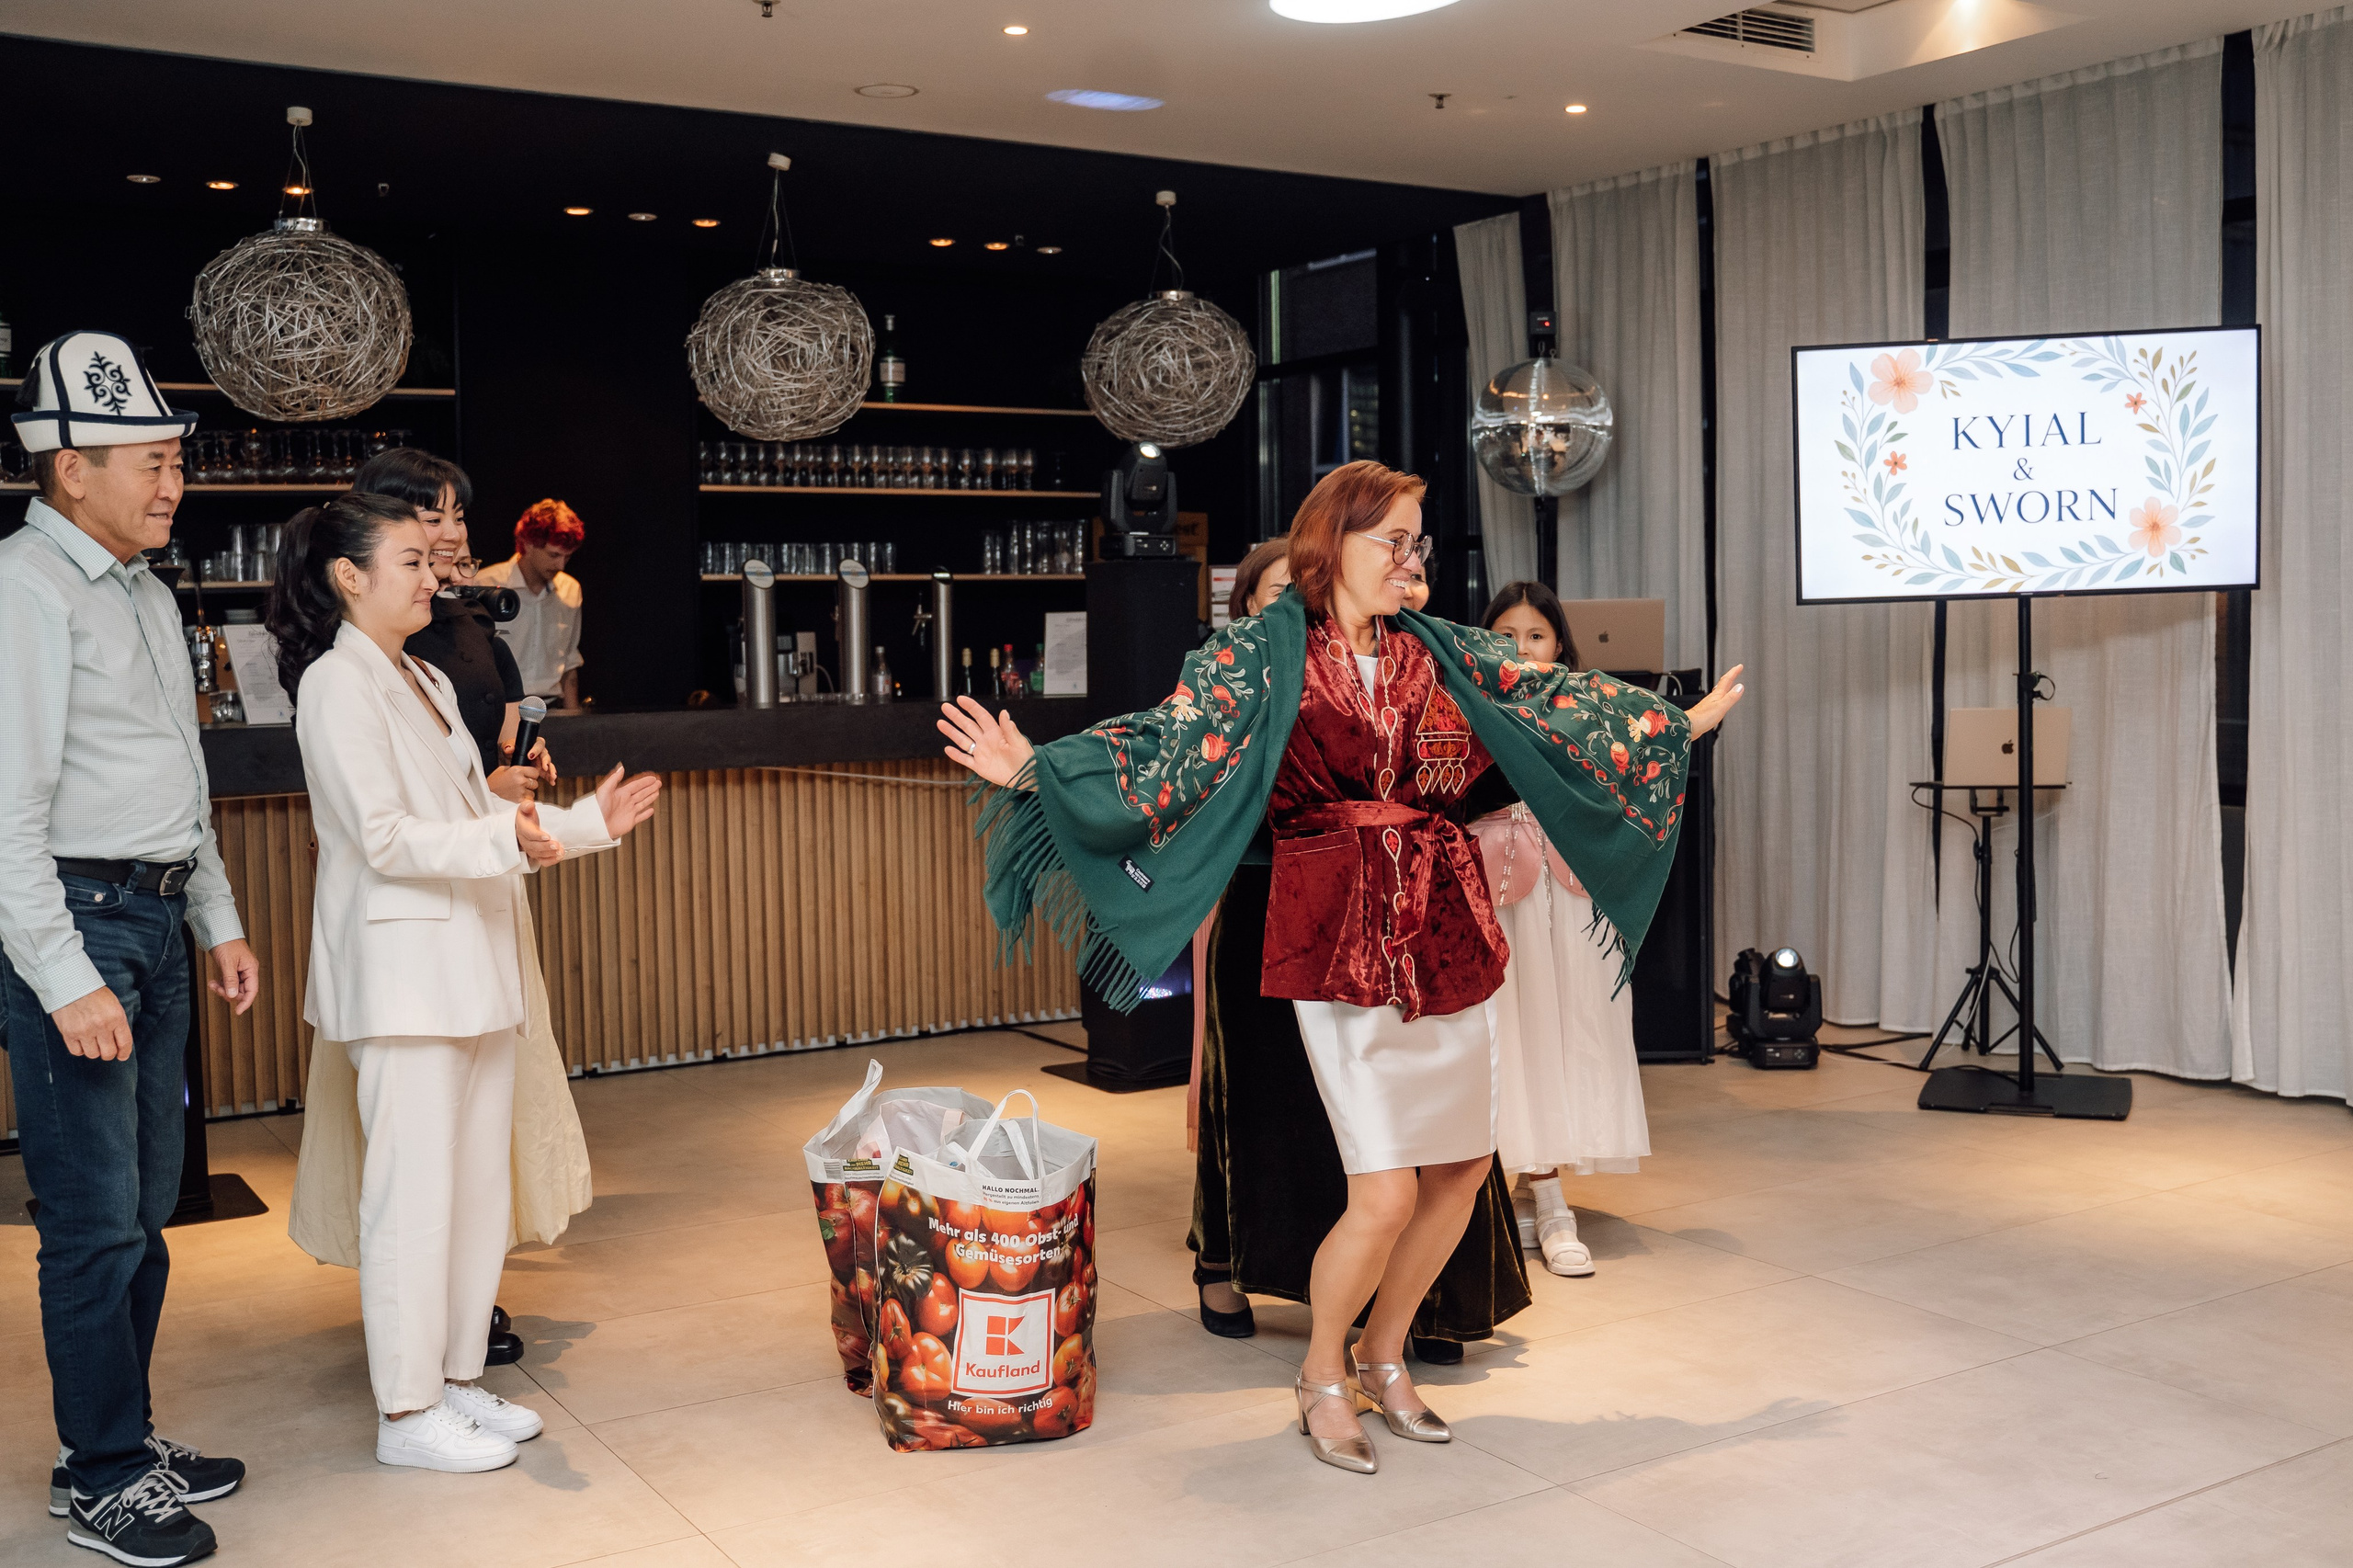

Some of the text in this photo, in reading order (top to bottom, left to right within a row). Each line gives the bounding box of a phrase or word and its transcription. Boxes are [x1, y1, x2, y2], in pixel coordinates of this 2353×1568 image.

[1952, 411, 2102, 450] KYIAL
[2012, 457, 2034, 482] &
[1943, 487, 2119, 528] SWORN
[927, 1212, 1079, 1248] Mehr als 400 Obst- und
[955, 1243, 1061, 1266] Gemüsesorten
[965, 1359, 1040, 1378] Kaufland
[948, 1397, 1053, 1415] Hier bin ich richtig
[94, 1502, 136, 1542] N
